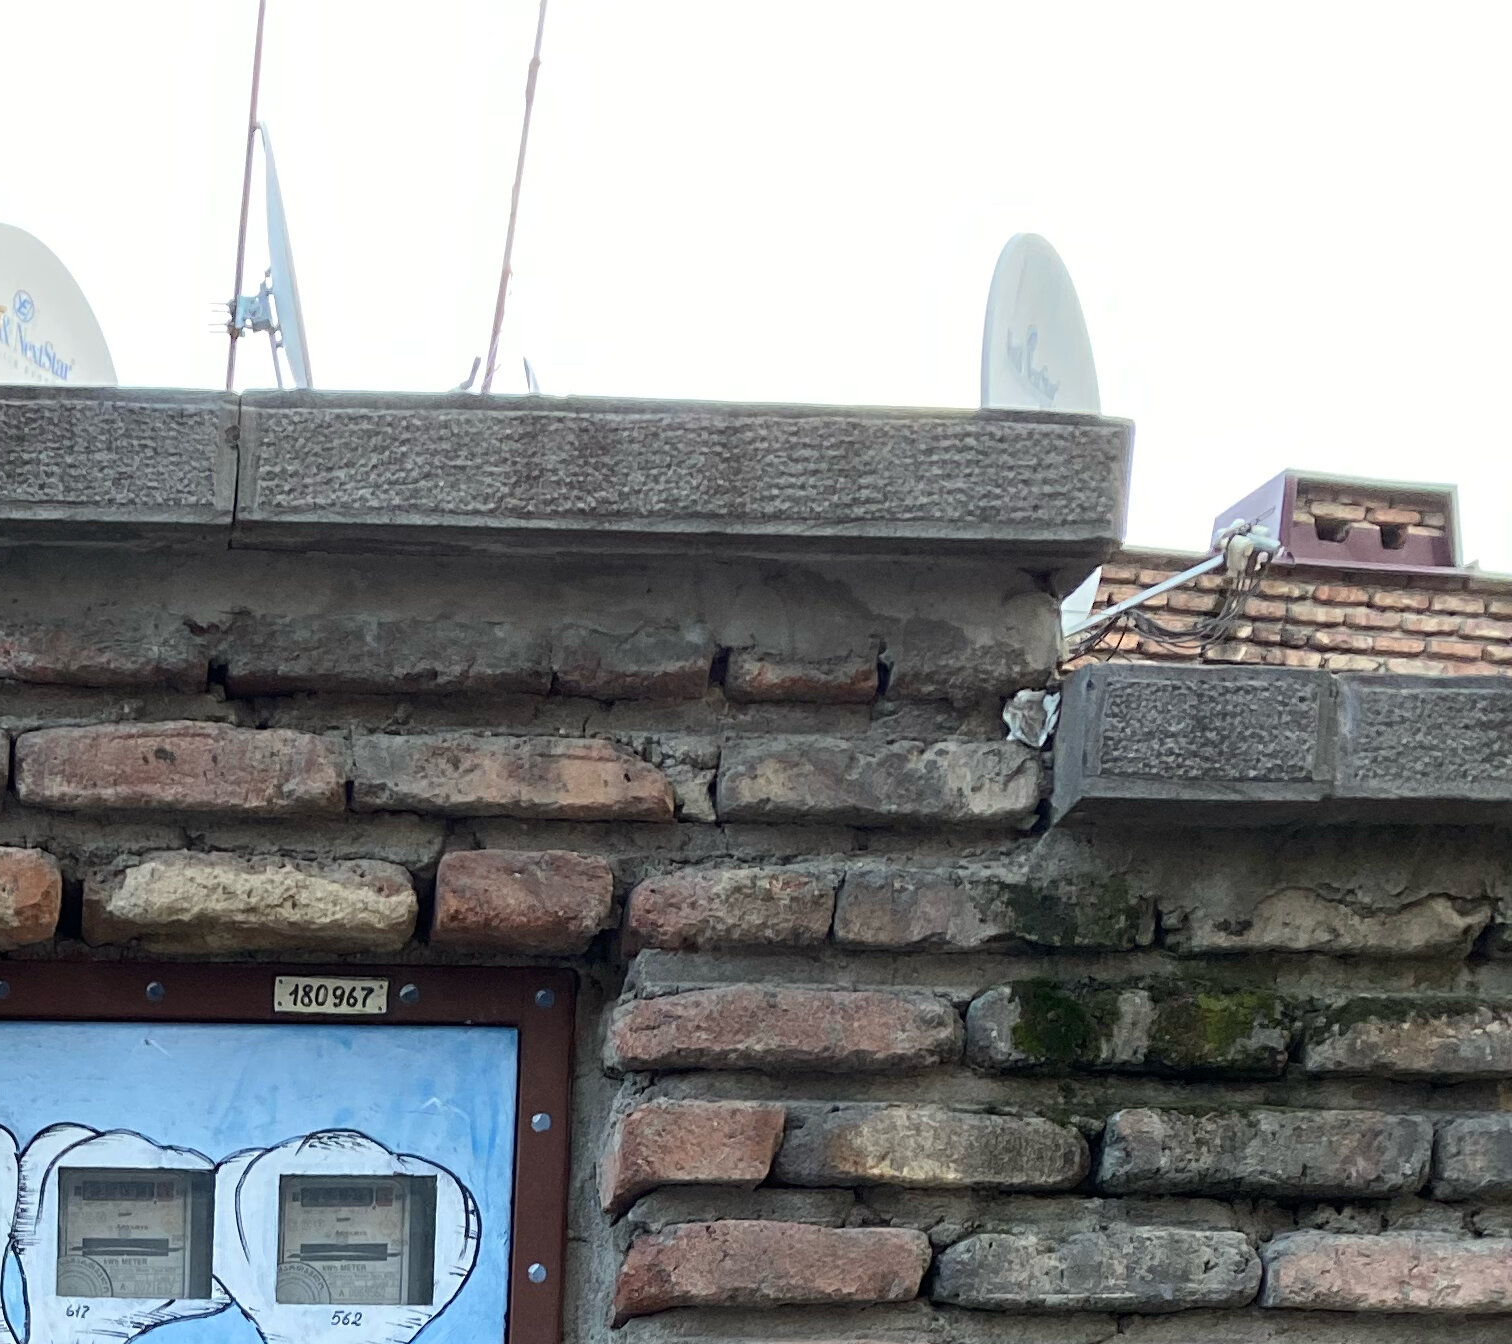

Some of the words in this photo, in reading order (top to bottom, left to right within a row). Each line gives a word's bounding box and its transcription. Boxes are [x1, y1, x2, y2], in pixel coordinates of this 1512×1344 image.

[289, 983, 375, 1008] 180967
[66, 1304, 90, 1319] 617
[331, 1310, 363, 1326] 562
